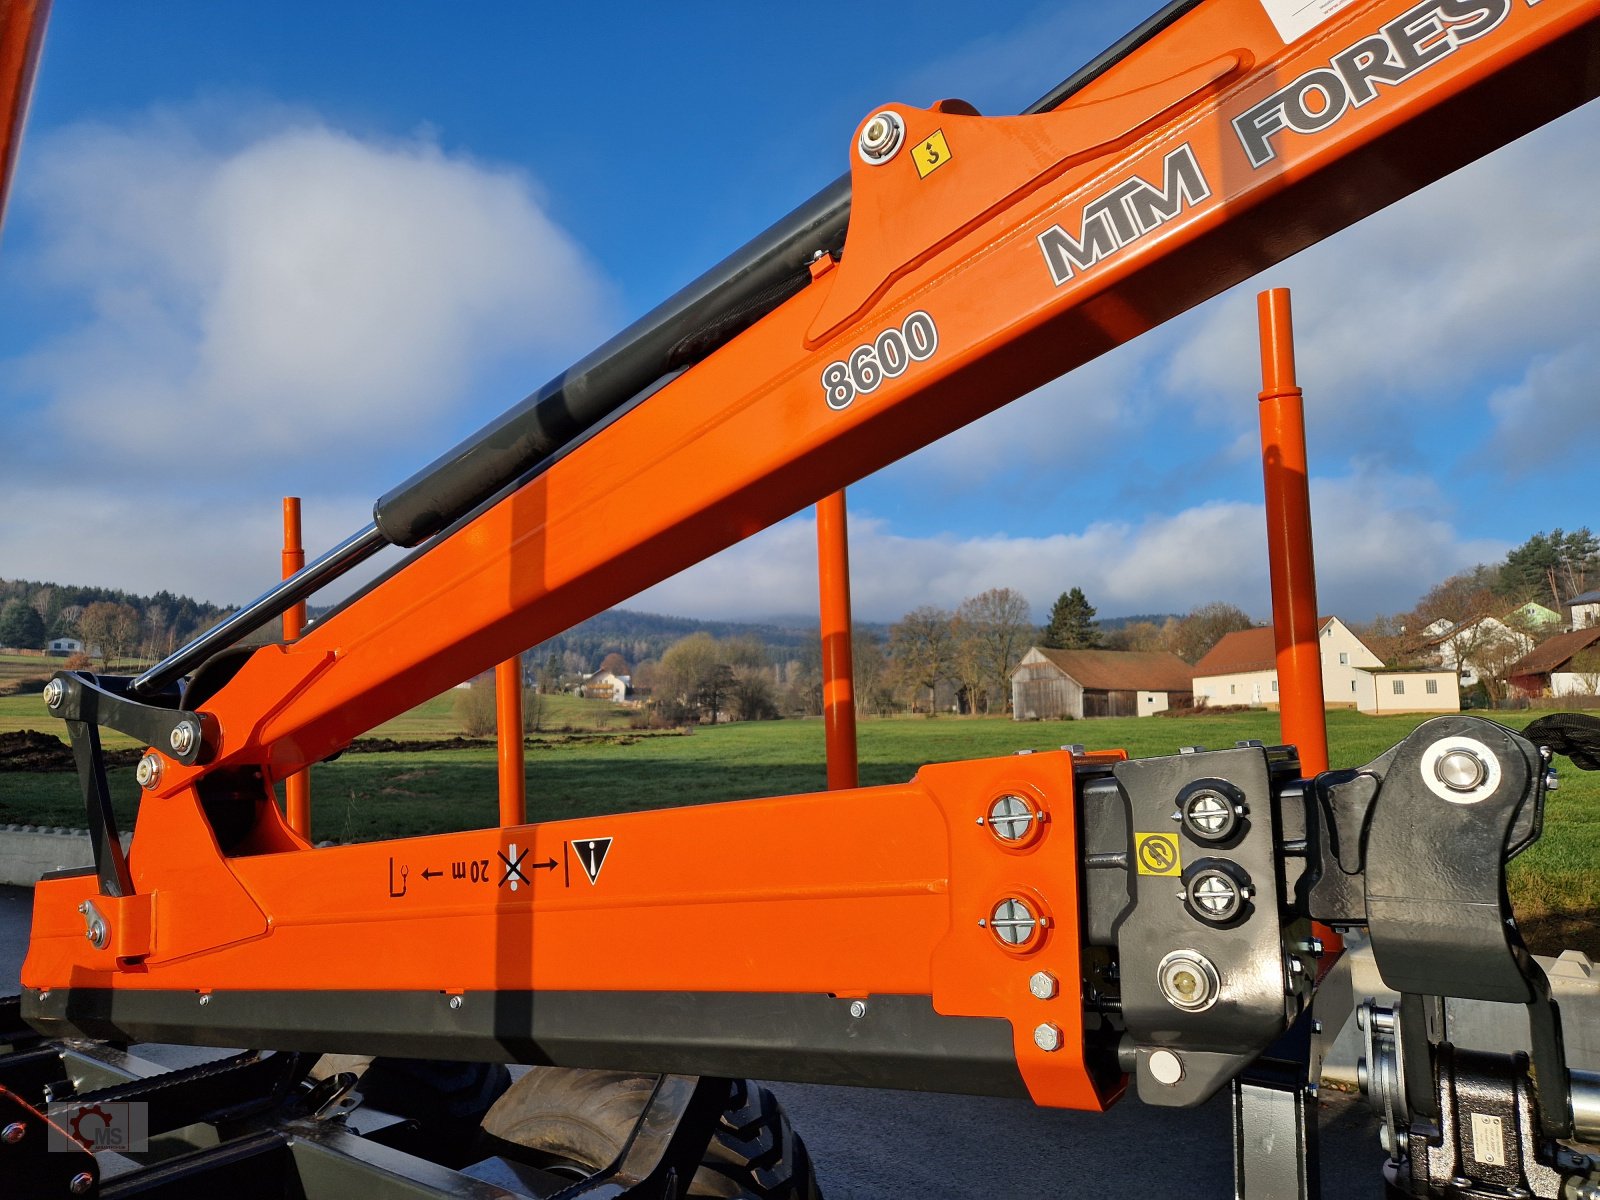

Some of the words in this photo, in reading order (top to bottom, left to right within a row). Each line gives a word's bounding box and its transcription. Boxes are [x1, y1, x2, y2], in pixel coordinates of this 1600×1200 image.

[1036, 142, 1212, 287] MTM
[1231, 0, 1551, 170] FORES
[821, 310, 939, 411] 8600
[452, 861, 466, 879] m
[470, 860, 489, 883] 20
